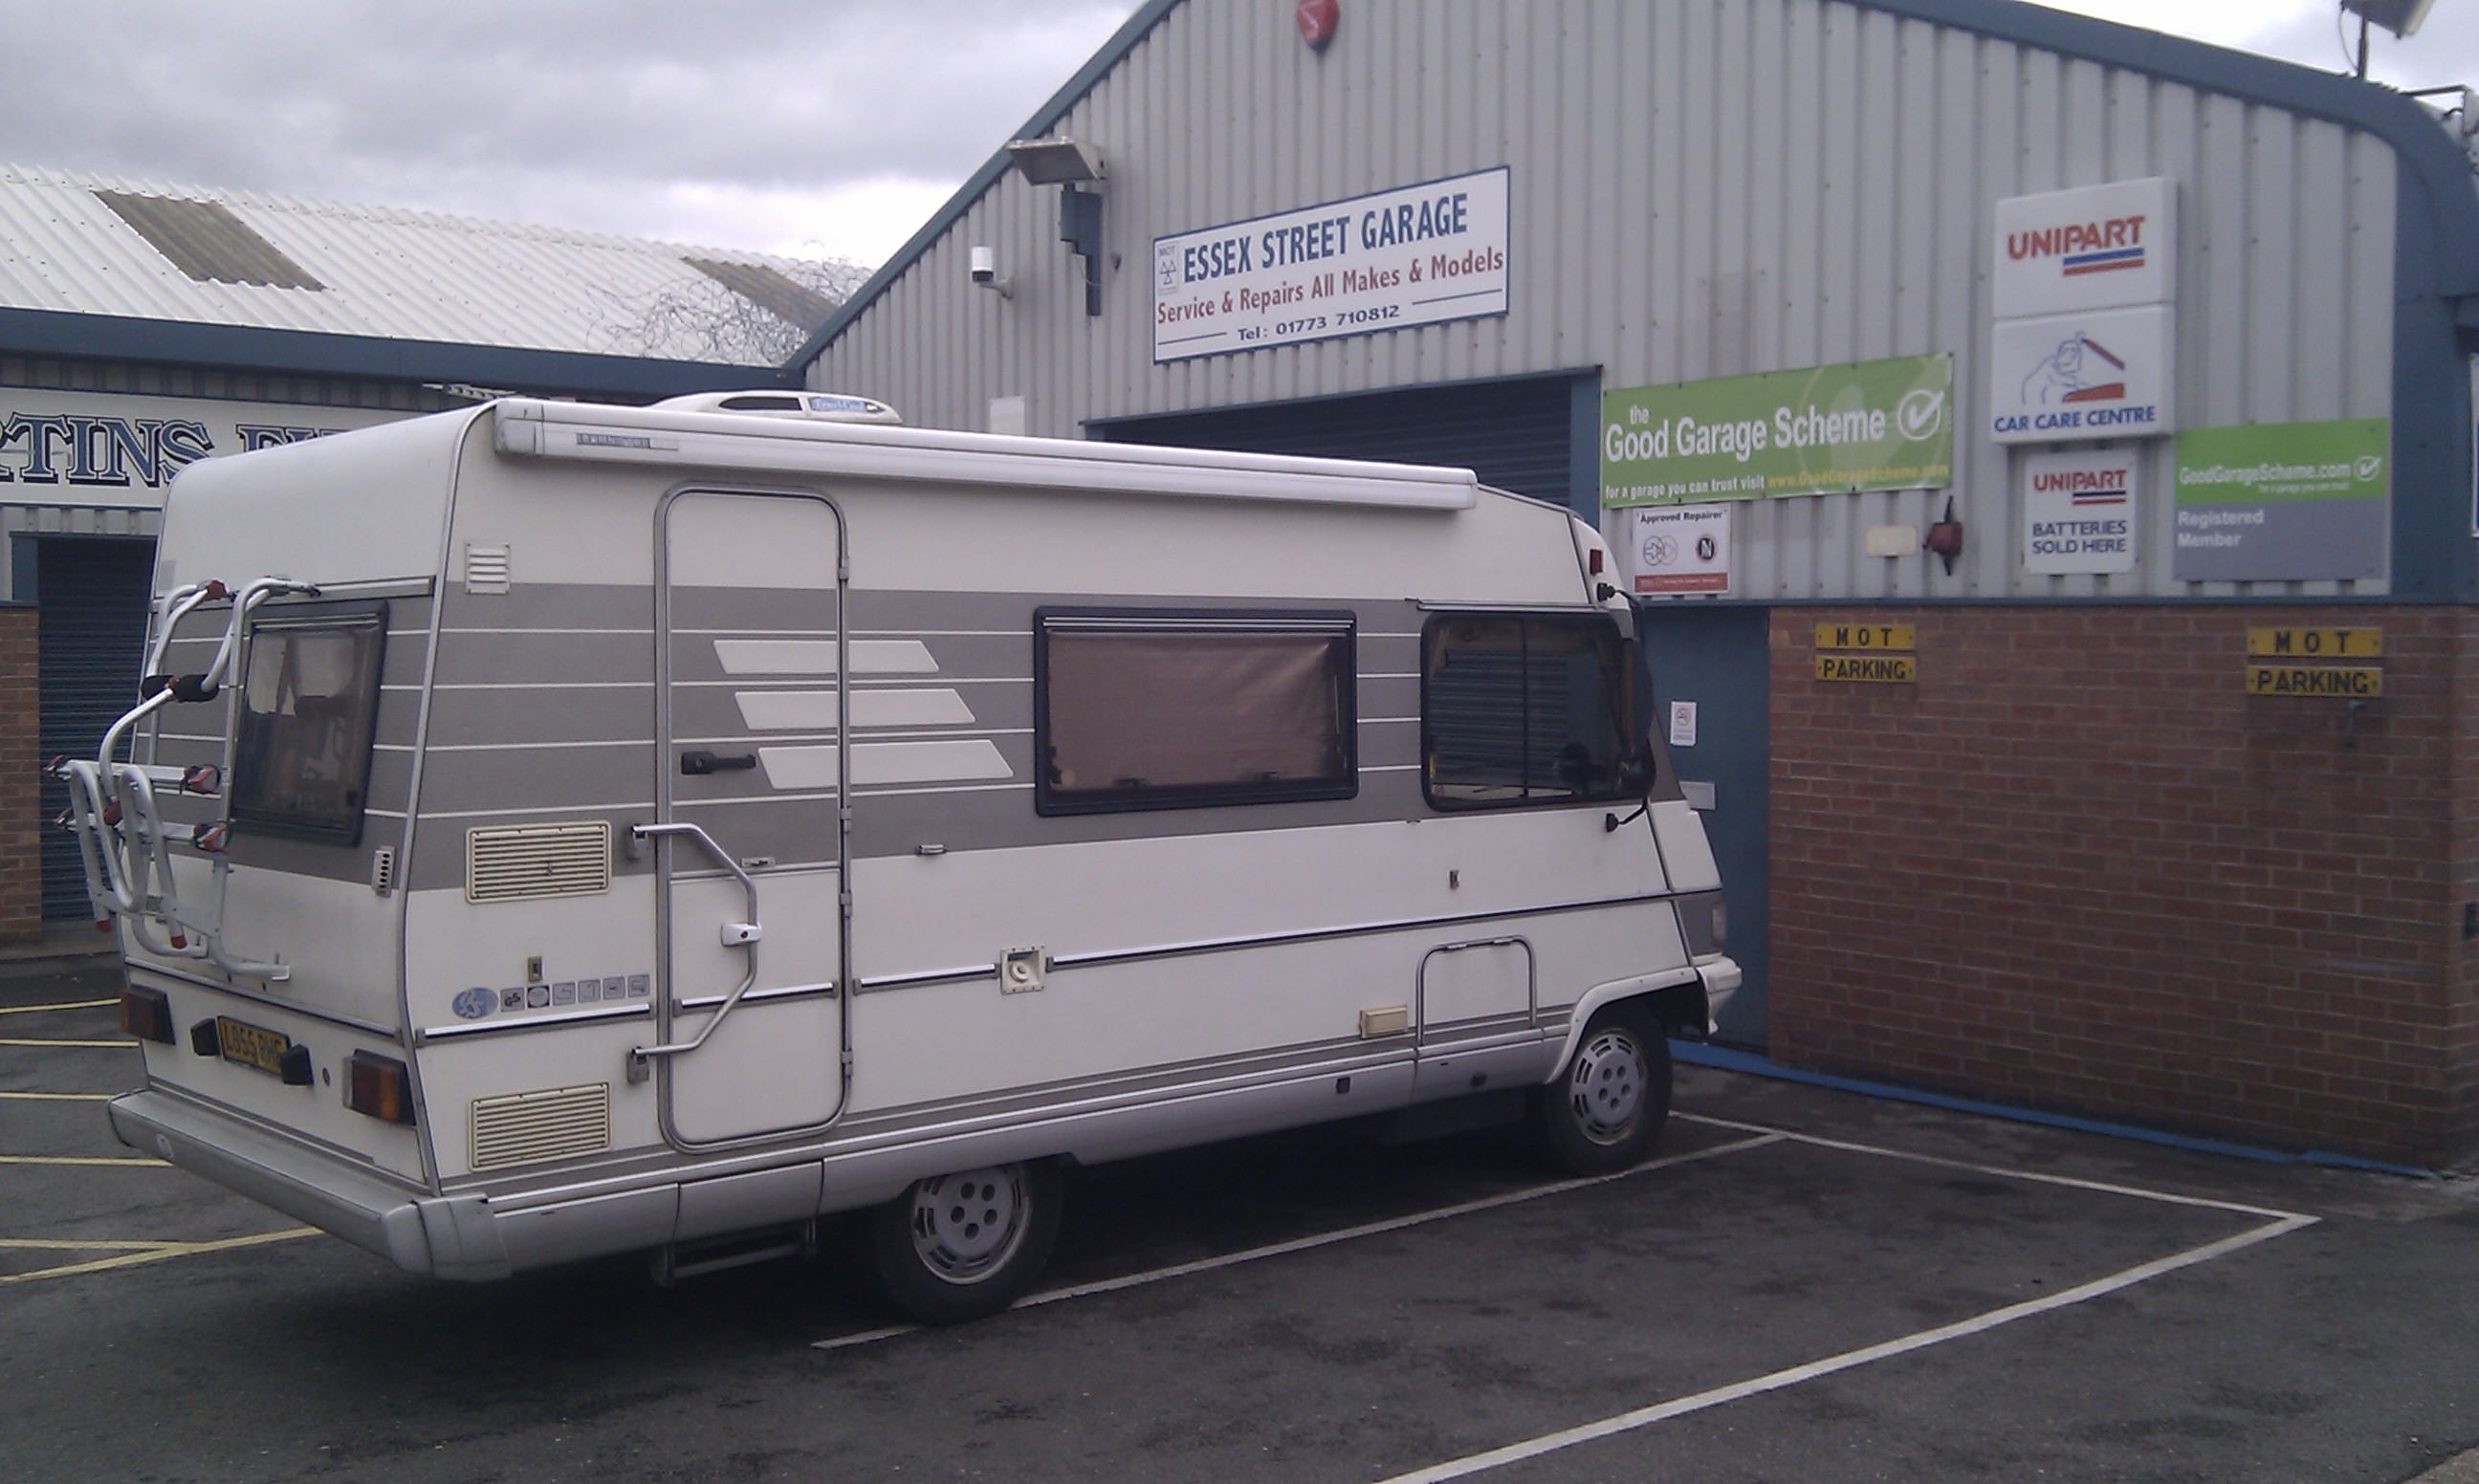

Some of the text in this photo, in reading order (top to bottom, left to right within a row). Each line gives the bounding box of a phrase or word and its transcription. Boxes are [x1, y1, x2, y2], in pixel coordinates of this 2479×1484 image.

[1184, 192, 1468, 283] ESSEX STREET GARAGE
[2007, 215, 2145, 261] UNIPART
[1157, 246, 1503, 324] Service & Repairs All Makes & Models
[1276, 316, 1327, 336] 01773
[1336, 304, 1400, 326] 710812
[1630, 404, 1650, 425] the
[1994, 405, 2155, 432] CAR CARE CENTRE
[1605, 404, 1886, 463] Good Garage Scheme
[0, 411, 215, 490] TINS
[2033, 469, 2128, 492] UNIPART
[2179, 462, 2351, 487] GoodGarageScheme.com
[1606, 485, 1619, 499] for
[1622, 488, 1629, 498] a
[1631, 484, 1665, 500] garage
[1668, 483, 1686, 497] you
[1689, 481, 1708, 494] can
[1711, 477, 1738, 491] trust
[1741, 474, 1766, 490] visit
[1640, 511, 1722, 524] Approved Repairer
[2032, 520, 2128, 536] BATTERIES
[2178, 509, 2265, 529] Registered
[2032, 538, 2127, 554] SOLD HERE
[2177, 533, 2242, 548] Member
[1823, 659, 1906, 680] PARKING
[2257, 670, 2368, 693] PARKING
